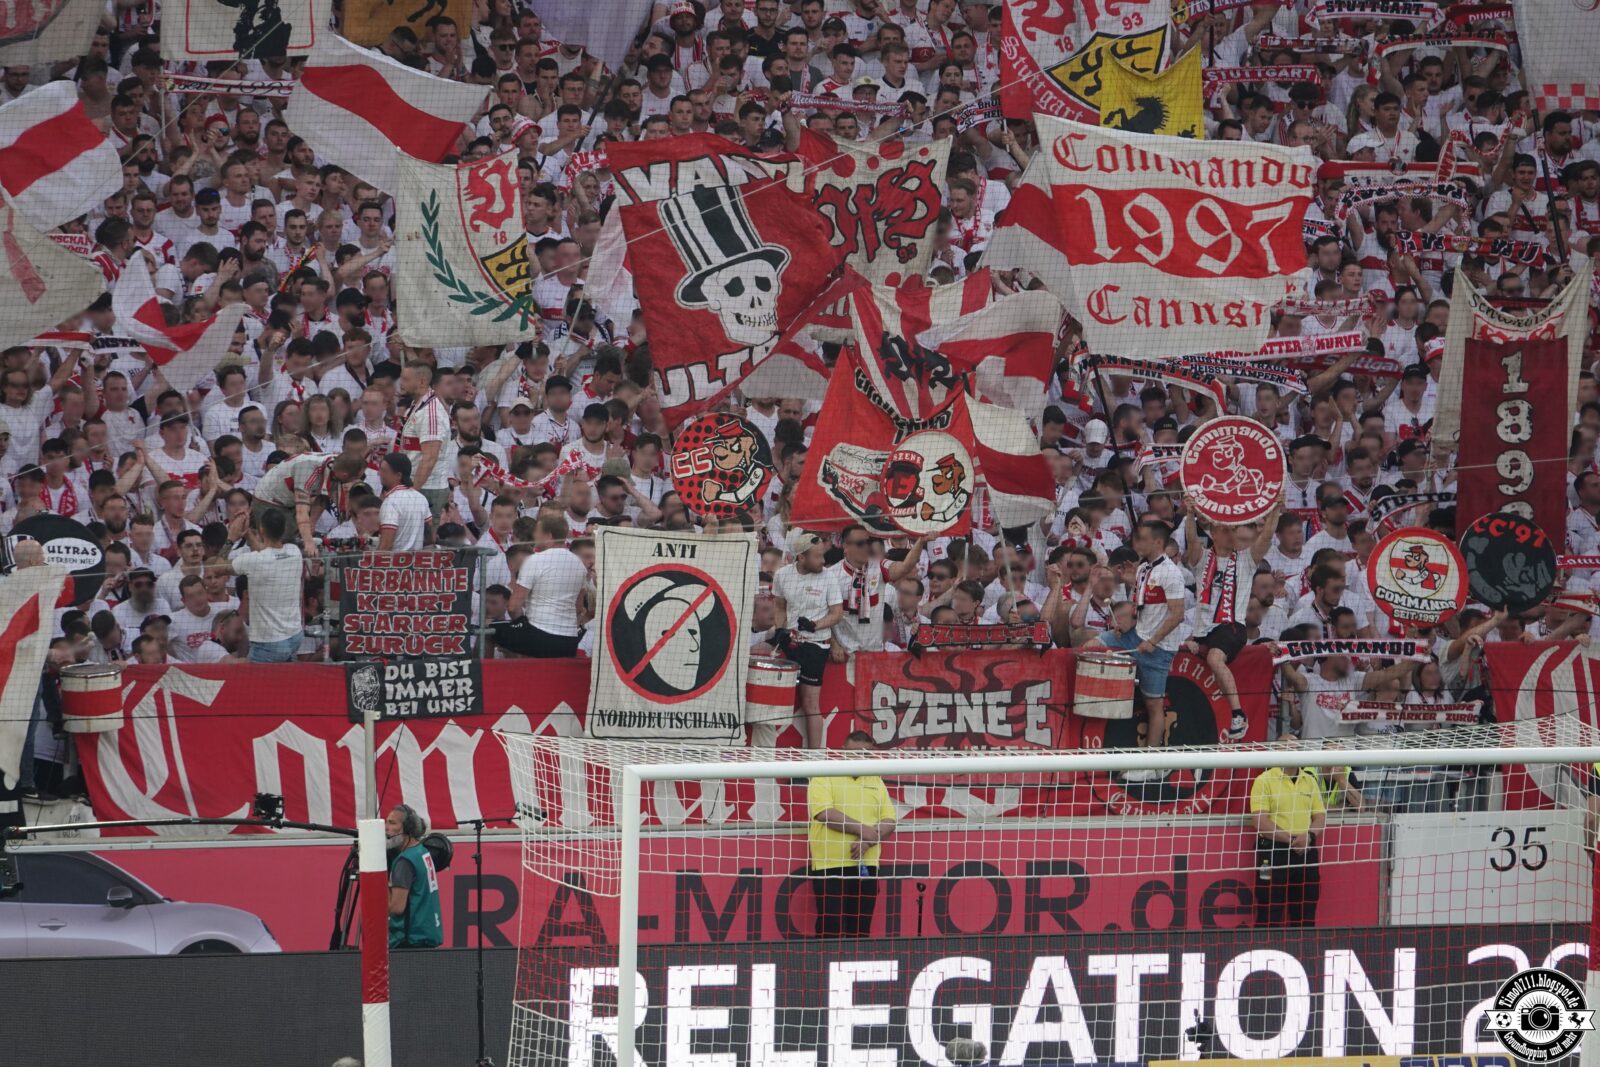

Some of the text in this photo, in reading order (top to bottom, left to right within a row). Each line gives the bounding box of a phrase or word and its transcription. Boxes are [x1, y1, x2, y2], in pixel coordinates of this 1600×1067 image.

[1326, 1, 1423, 15] STUTTGART
[1121, 12, 1144, 31] 93
[1055, 36, 1075, 53] 18
[1000, 36, 1083, 121] Stuttgart
[1207, 68, 1315, 81] STUTTGART
[1053, 132, 1313, 190] Commando
[493, 232, 507, 245] 18
[1075, 187, 1296, 275] 1997
[1315, 335, 1362, 352] KURVE
[1132, 368, 1162, 379] KURVE
[1190, 363, 1229, 375] HEISST
[1186, 426, 1277, 464] Commando
[1187, 481, 1281, 514] Cannstatt
[47, 545, 97, 557] ULTRAS
[359, 551, 455, 569] JEDER
[652, 542, 697, 559] ANTI
[344, 567, 469, 592] VERBANNTE
[356, 593, 457, 612] KEHRT
[1375, 587, 1457, 610] COMMANDO
[343, 613, 468, 634] STÄRKER
[345, 633, 467, 655] ZURÜCK
[916, 625, 1005, 646] SZENE
[1287, 641, 1417, 656] COMMANDO
[385, 659, 472, 681] DU BIST
[385, 677, 474, 700] IMMER
[384, 697, 475, 715] BEI UNS!
[872, 680, 1051, 747] SZENE E
[1341, 711, 1379, 721] KEHRT
[597, 709, 738, 730] NORDDEUTSCHLAND
[1489, 827, 1548, 871] 35
[568, 948, 1418, 1067] RELEGATION
